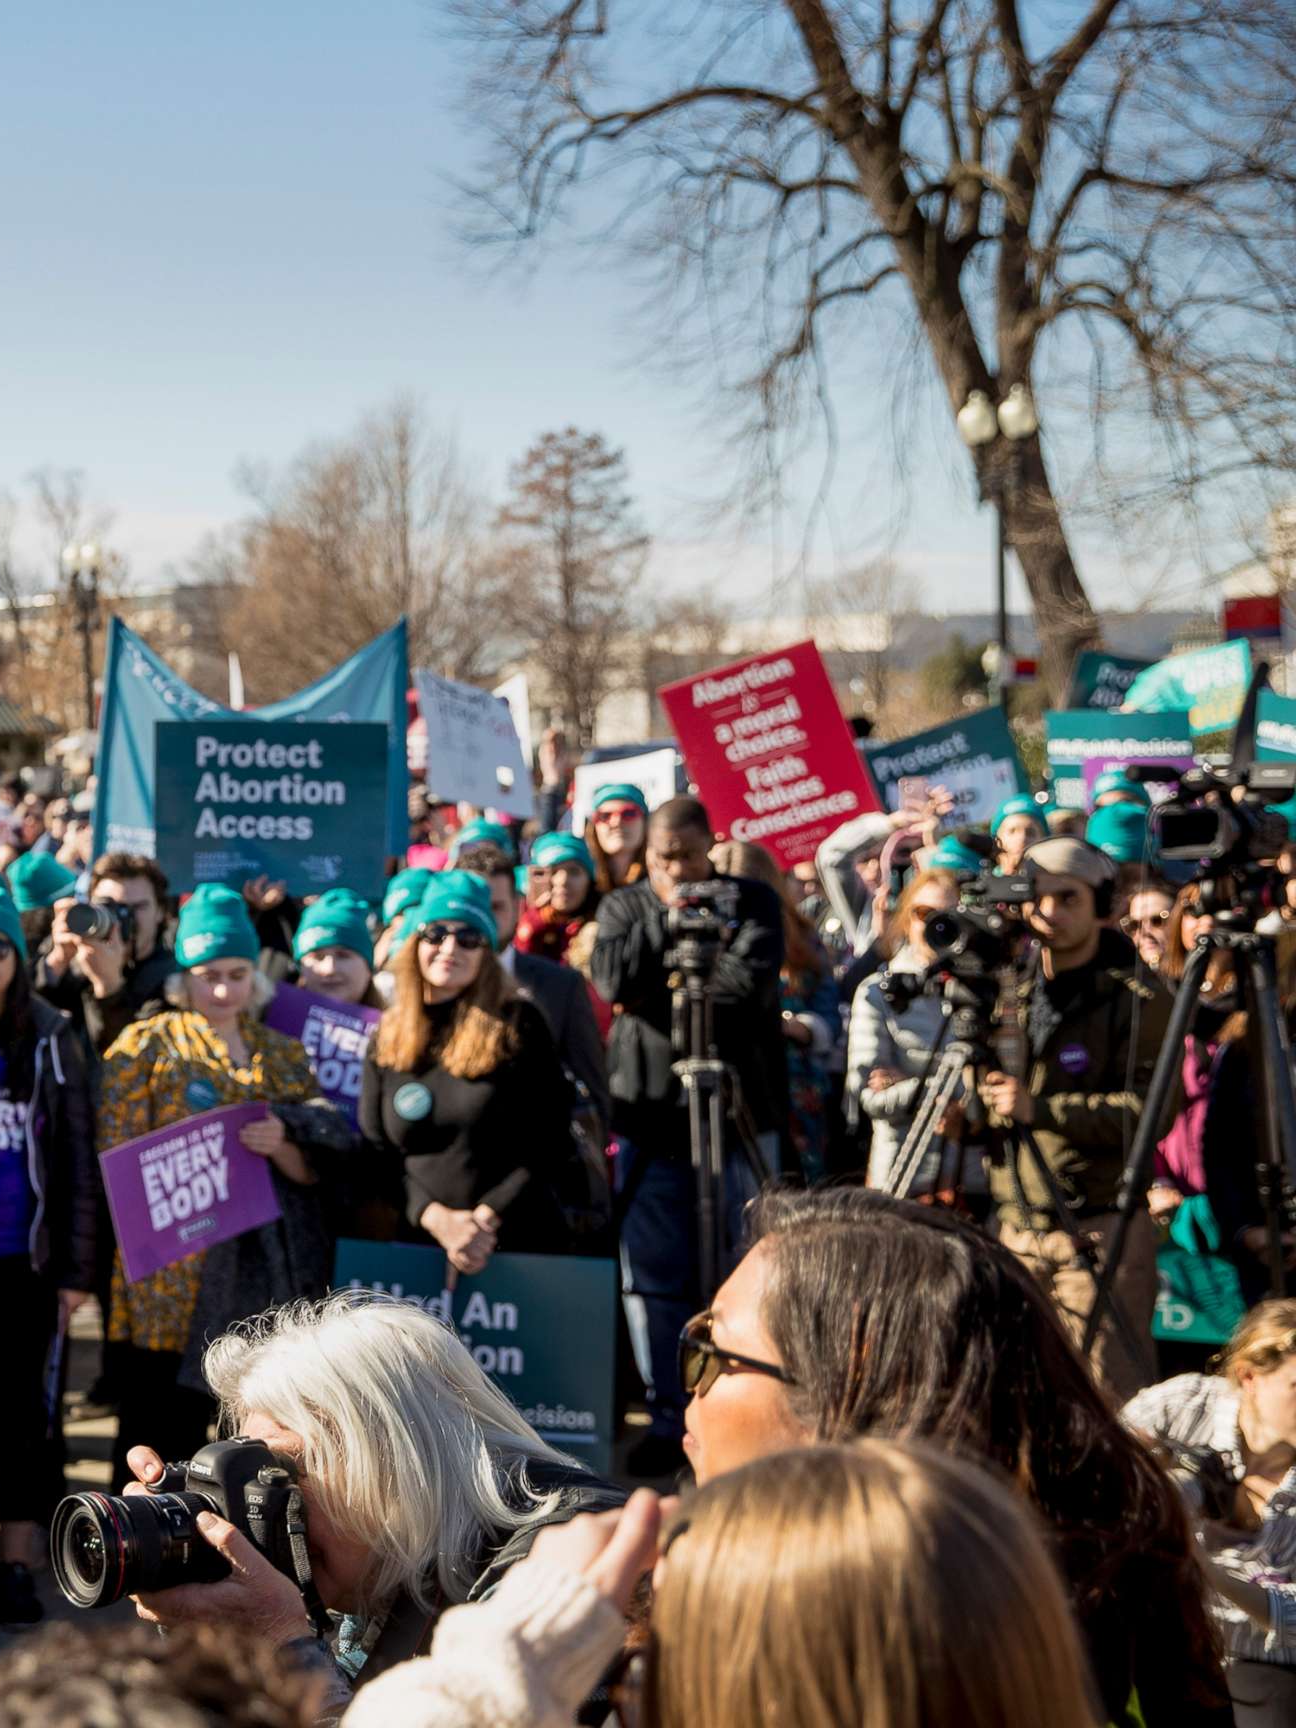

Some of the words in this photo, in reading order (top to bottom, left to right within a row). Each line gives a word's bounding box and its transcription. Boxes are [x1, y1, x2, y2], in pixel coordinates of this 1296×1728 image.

[691, 657, 796, 709] Abortion
[714, 723, 733, 745] a
[731, 694, 802, 738] moral
[195, 736, 323, 769] Protect
[724, 724, 808, 763] choice.
[871, 731, 971, 783] Protect
[194, 772, 347, 805] Abortion
[744, 754, 809, 791] Faith
[743, 775, 826, 816] Values
[194, 807, 314, 840] Access
[729, 790, 859, 843] Conscience
[141, 1135, 225, 1206] EVERY
[149, 1156, 230, 1233] BODY
[461, 1291, 519, 1330] An
[190, 1460, 212, 1477] Canon
[247, 1494, 263, 1505] EOS
